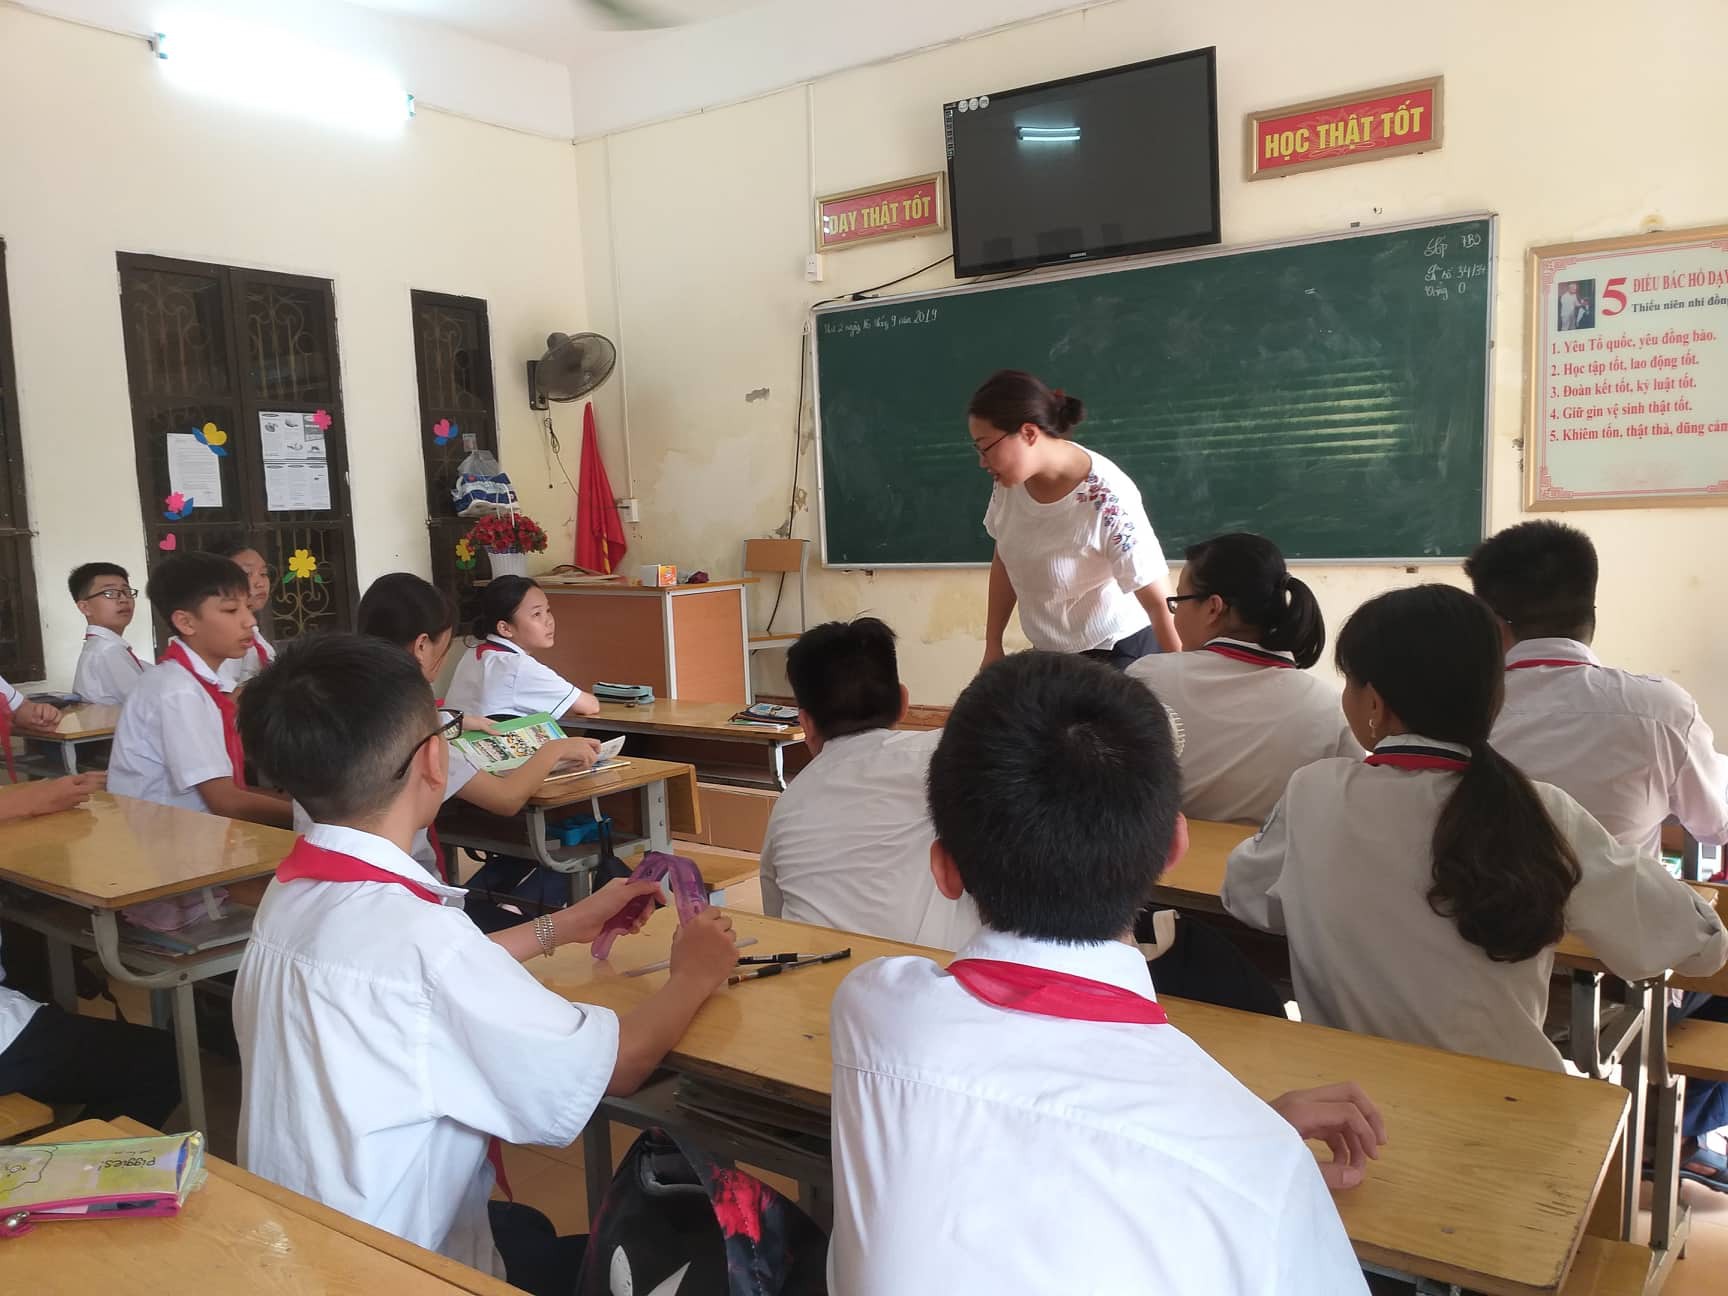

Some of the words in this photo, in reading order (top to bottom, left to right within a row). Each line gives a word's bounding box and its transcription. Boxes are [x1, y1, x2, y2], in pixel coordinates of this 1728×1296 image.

[1265, 128, 1309, 160] HỌC
[1317, 114, 1374, 149] THẬT
[1381, 100, 1424, 138] TỐT
[829, 210, 857, 237] DẠY
[862, 200, 899, 230] THẬT
[903, 190, 931, 221] TỐT
[1458, 281, 1466, 294] 0
[1602, 277, 1627, 316] 5
[1663, 270, 1686, 290] BÁC
[1707, 293, 1728, 306] đồn
[914, 309, 938, 324] 2019
[1551, 343, 1560, 354] 1.
[1564, 341, 1585, 353] Yêu
[1639, 333, 1658, 350] yêu
[1551, 366, 1560, 376] 2.
[1564, 363, 1585, 377] Học
[1588, 360, 1605, 376] tập
[1630, 358, 1646, 370] lao
[1650, 355, 1678, 370] động
[1681, 350, 1699, 365] tốt.
[1550, 386, 1560, 398] 3.
[1563, 384, 1591, 397] Đoàn
[1595, 379, 1611, 395] kết
[1653, 377, 1675, 392] luật
[1678, 372, 1697, 388] tốt.
[1550, 408, 1560, 420] 4.
[1563, 406, 1584, 419] Giữ
[1606, 404, 1618, 419] vệ
[1622, 402, 1645, 415] sinh
[1648, 400, 1671, 415] thật
[1674, 396, 1692, 411] tốt.
[1550, 430, 1559, 442] 5.
[1563, 427, 1598, 441] Khiêm
[1626, 425, 1648, 439] thật
[1676, 421, 1704, 436] dũng
